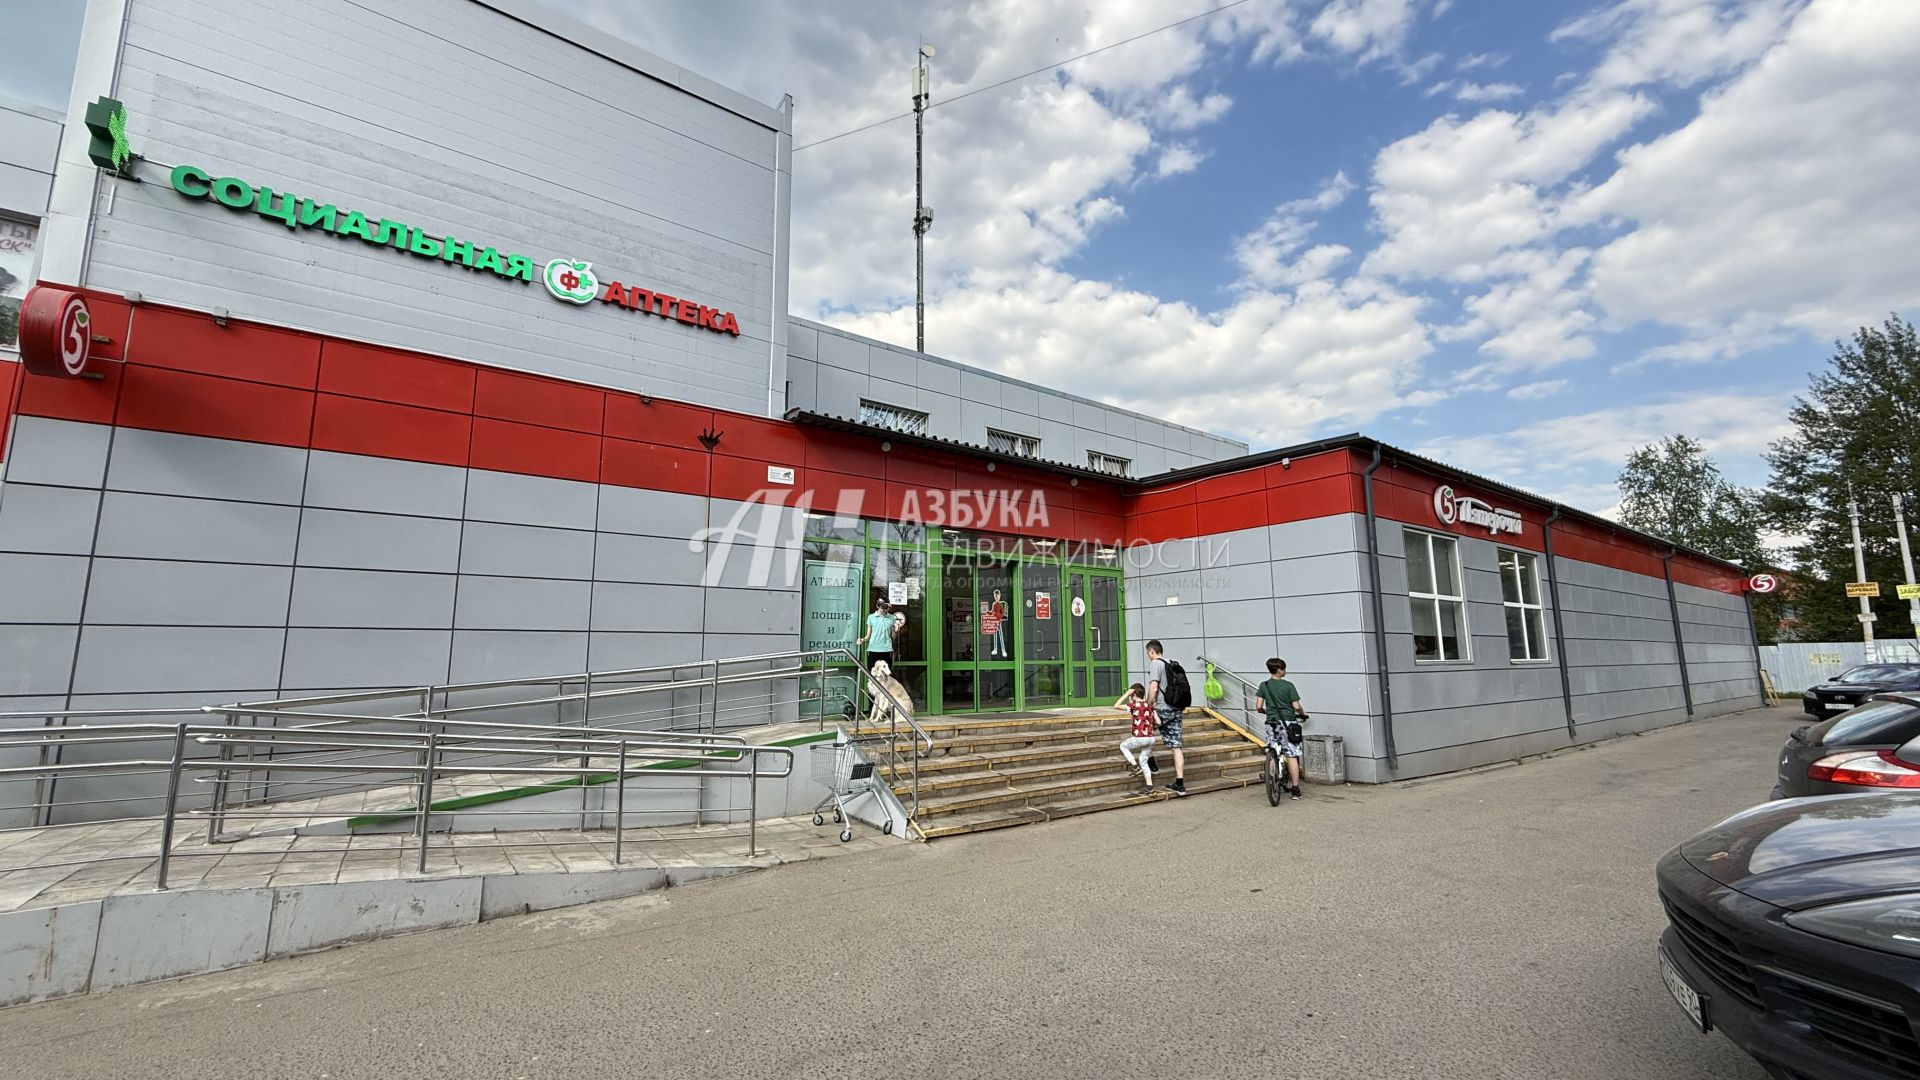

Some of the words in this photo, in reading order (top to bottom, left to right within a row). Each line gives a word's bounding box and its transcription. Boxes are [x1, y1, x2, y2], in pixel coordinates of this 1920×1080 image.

[169, 164, 534, 283] СОЦИАЛЬНАЯ
[602, 281, 740, 337] АПТЕКА
[809, 576, 854, 588] АТЕЛЬЕ
[812, 611, 852, 620] пошив
[827, 626, 835, 634] и
[808, 640, 853, 651] ремонт
